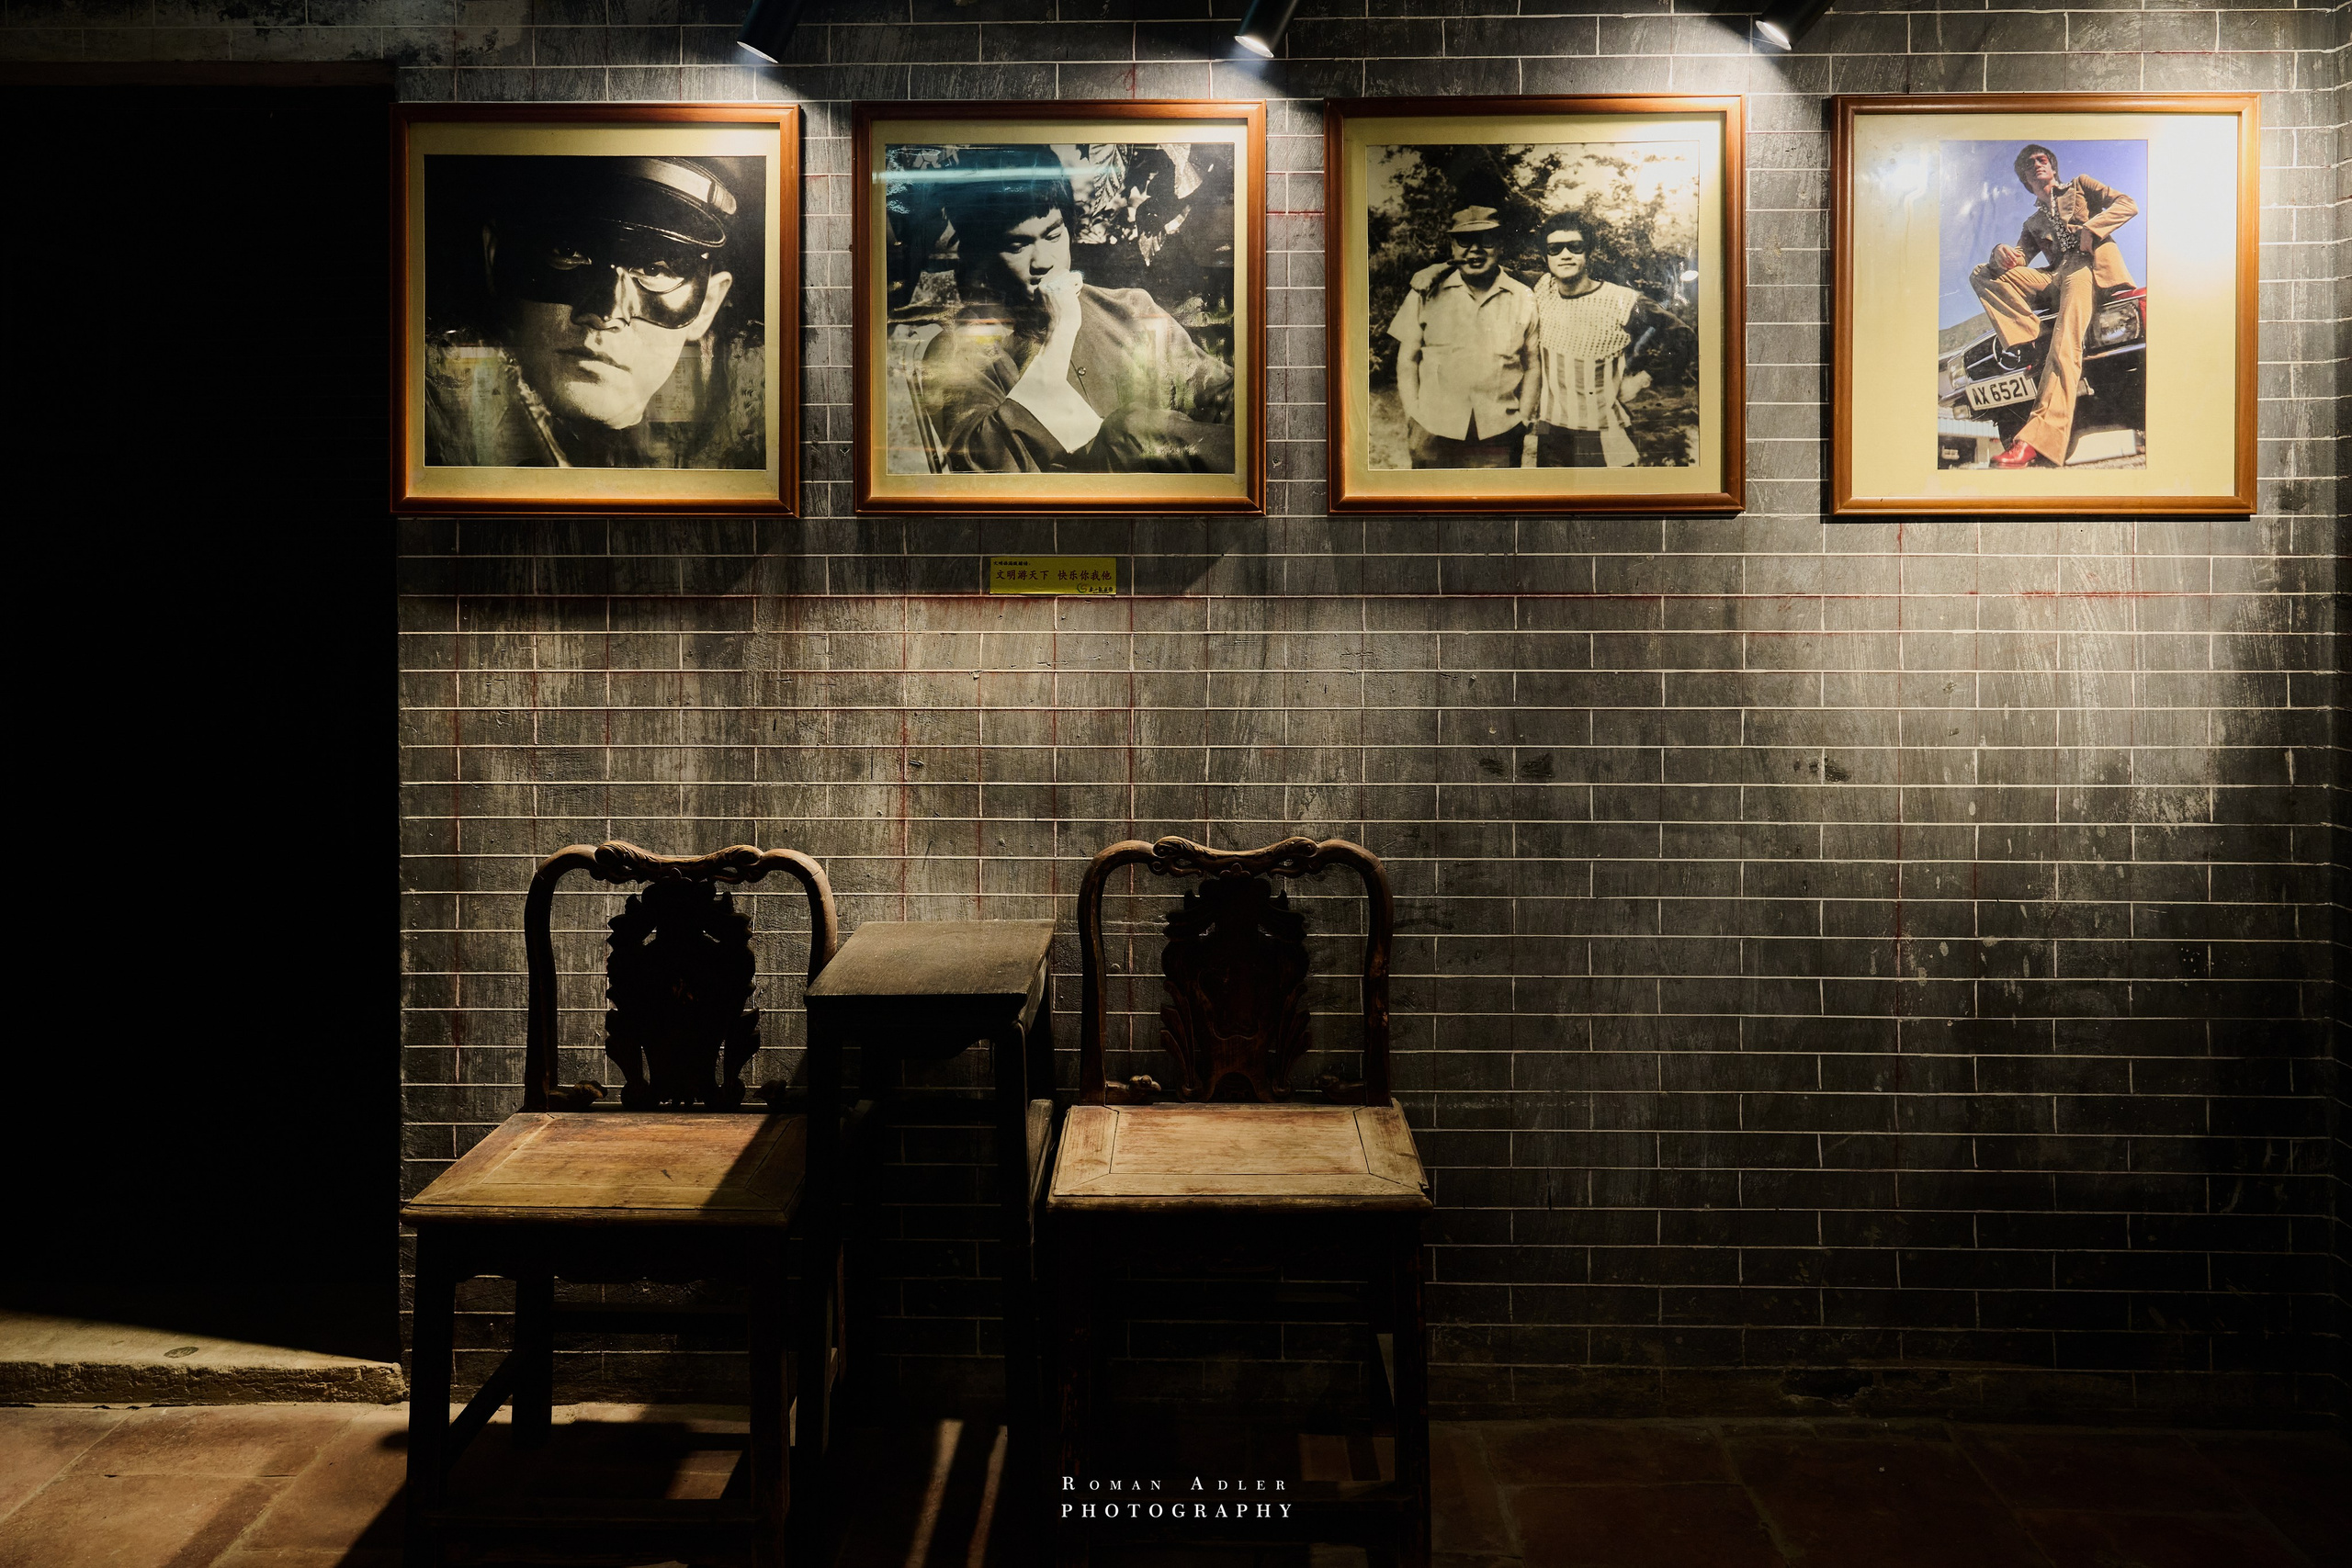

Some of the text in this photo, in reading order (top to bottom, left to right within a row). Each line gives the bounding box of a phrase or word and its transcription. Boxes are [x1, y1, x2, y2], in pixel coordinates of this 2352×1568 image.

[1973, 377, 2029, 406] AX 6521
[995, 569, 1113, 581] 文明游天下 快乐你我他
